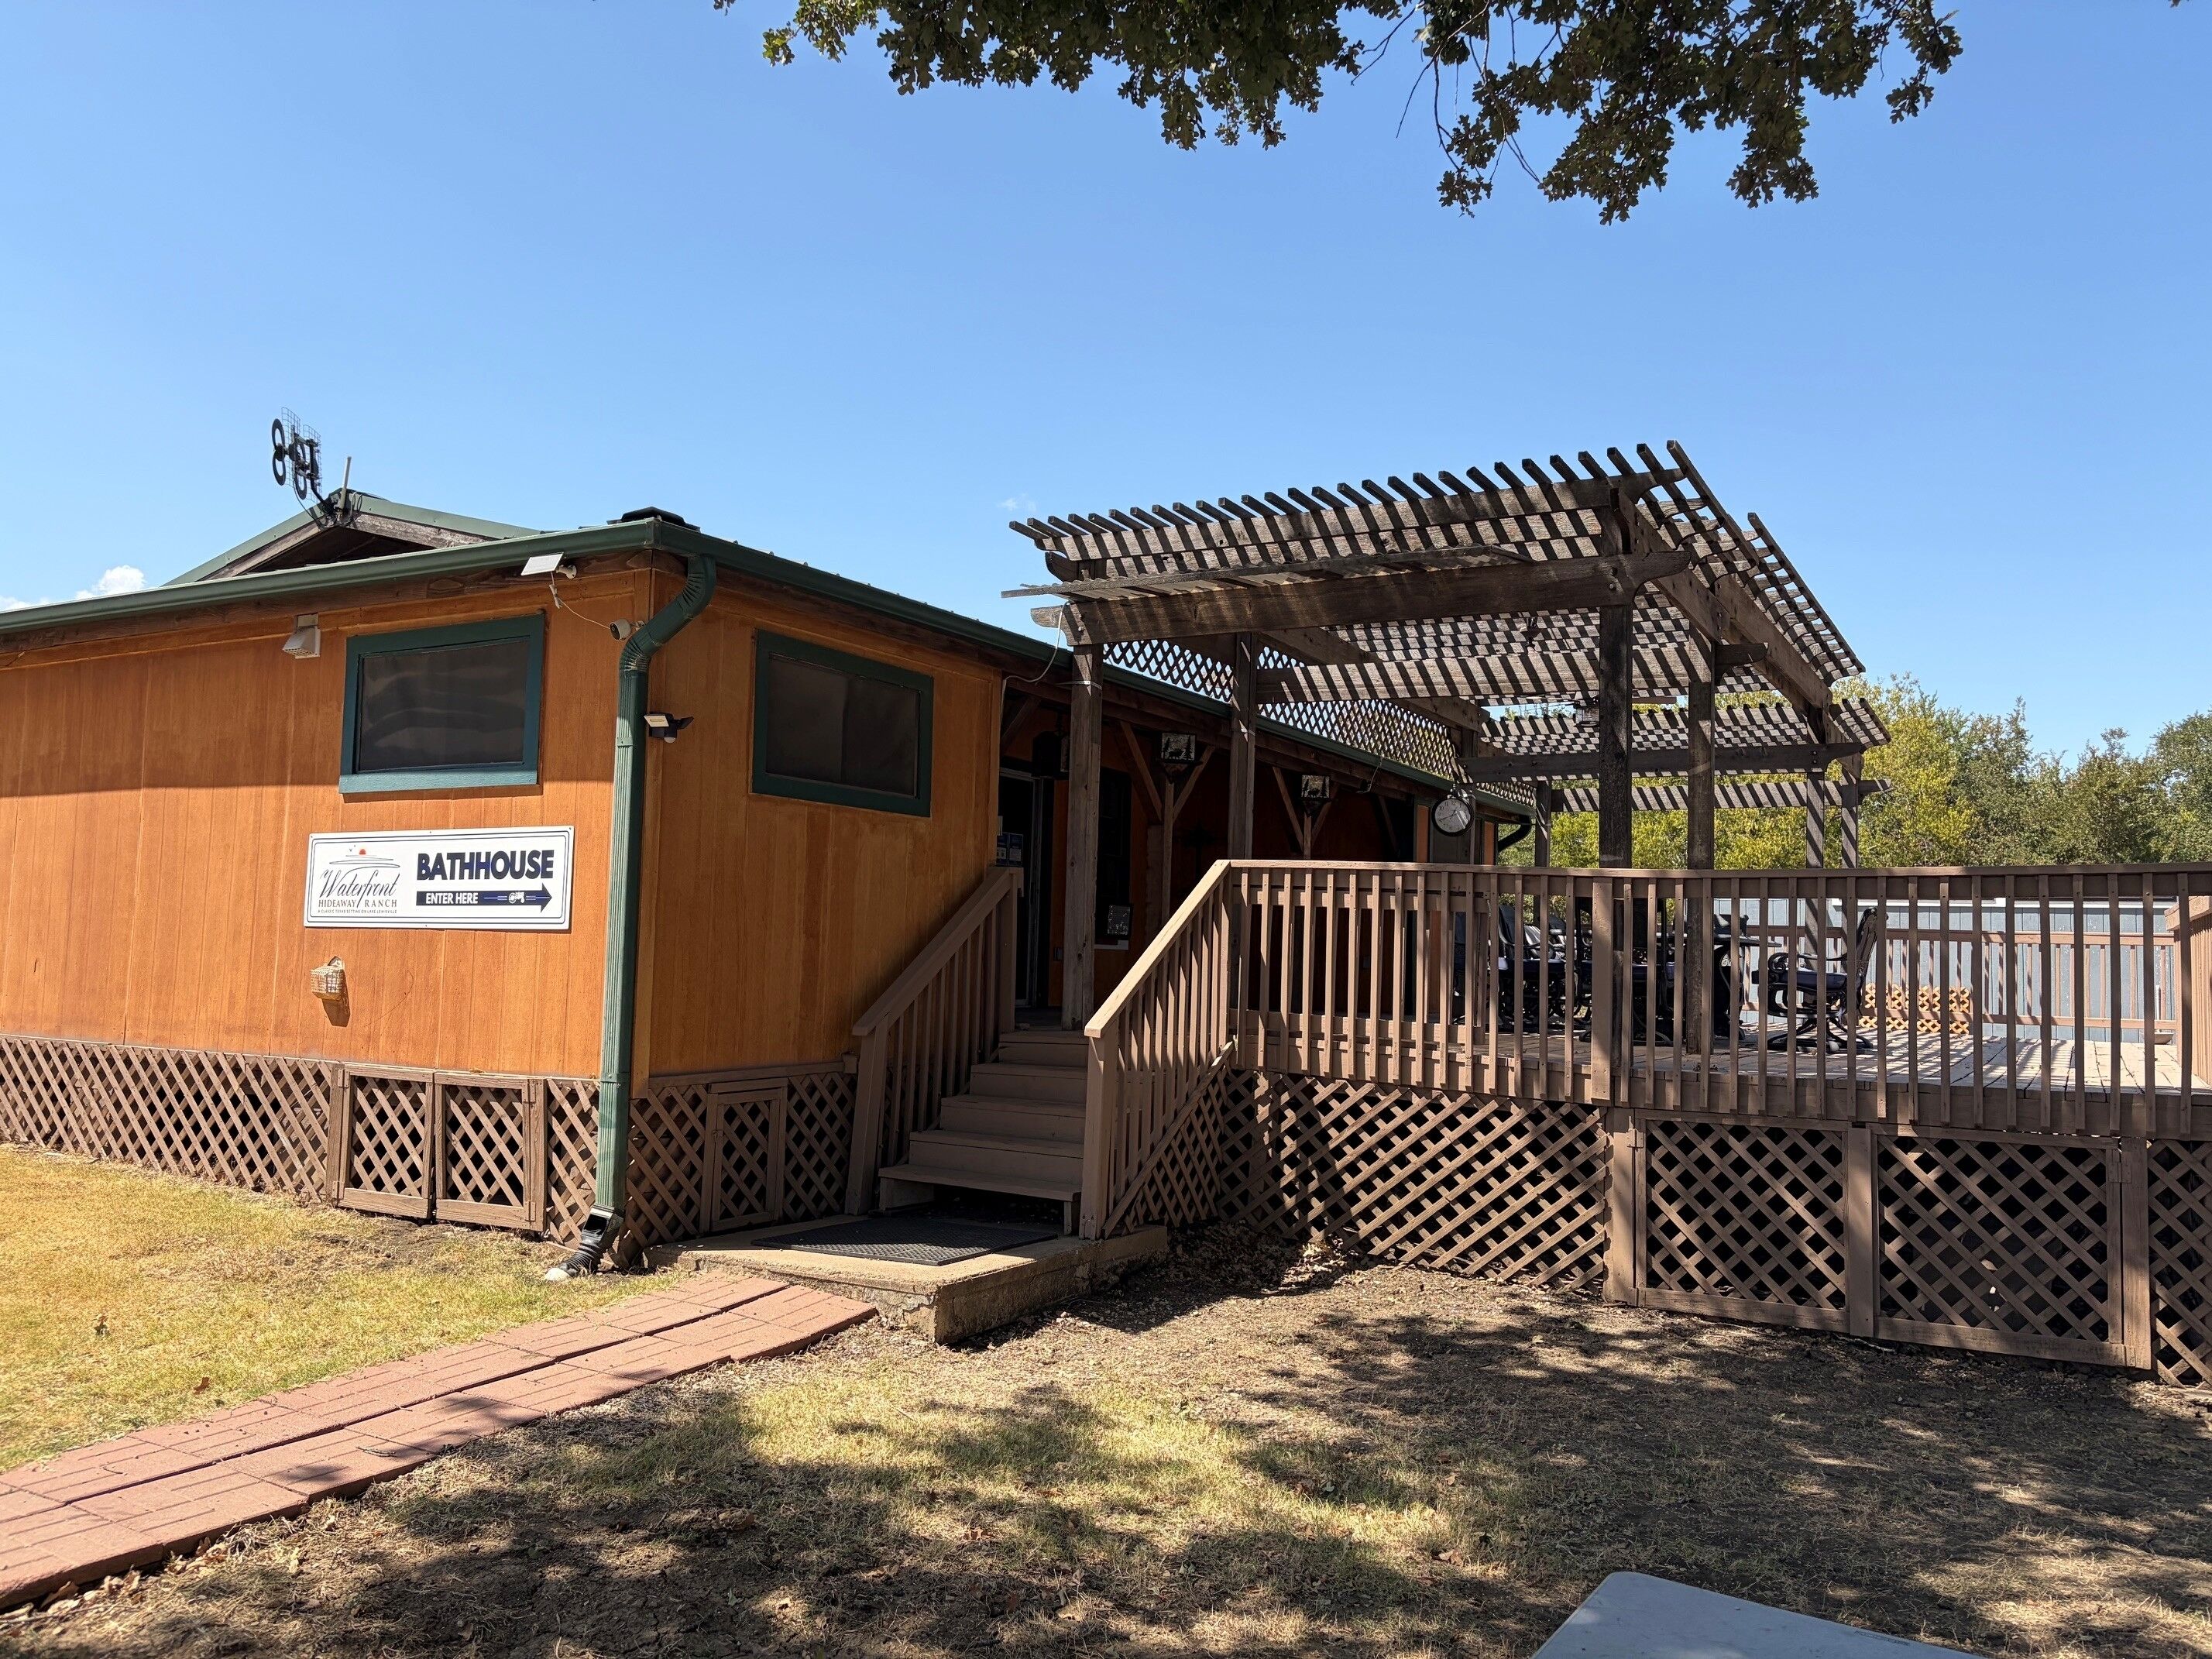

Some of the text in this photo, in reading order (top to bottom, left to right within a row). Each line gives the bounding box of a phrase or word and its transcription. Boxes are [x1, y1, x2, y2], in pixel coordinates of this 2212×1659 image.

[417, 850, 555, 881] BATHHOUSE
[319, 870, 400, 908] Waterfront
[426, 892, 479, 905] ENTER HERE
[318, 899, 397, 908] HIDEAWAY RANCH
